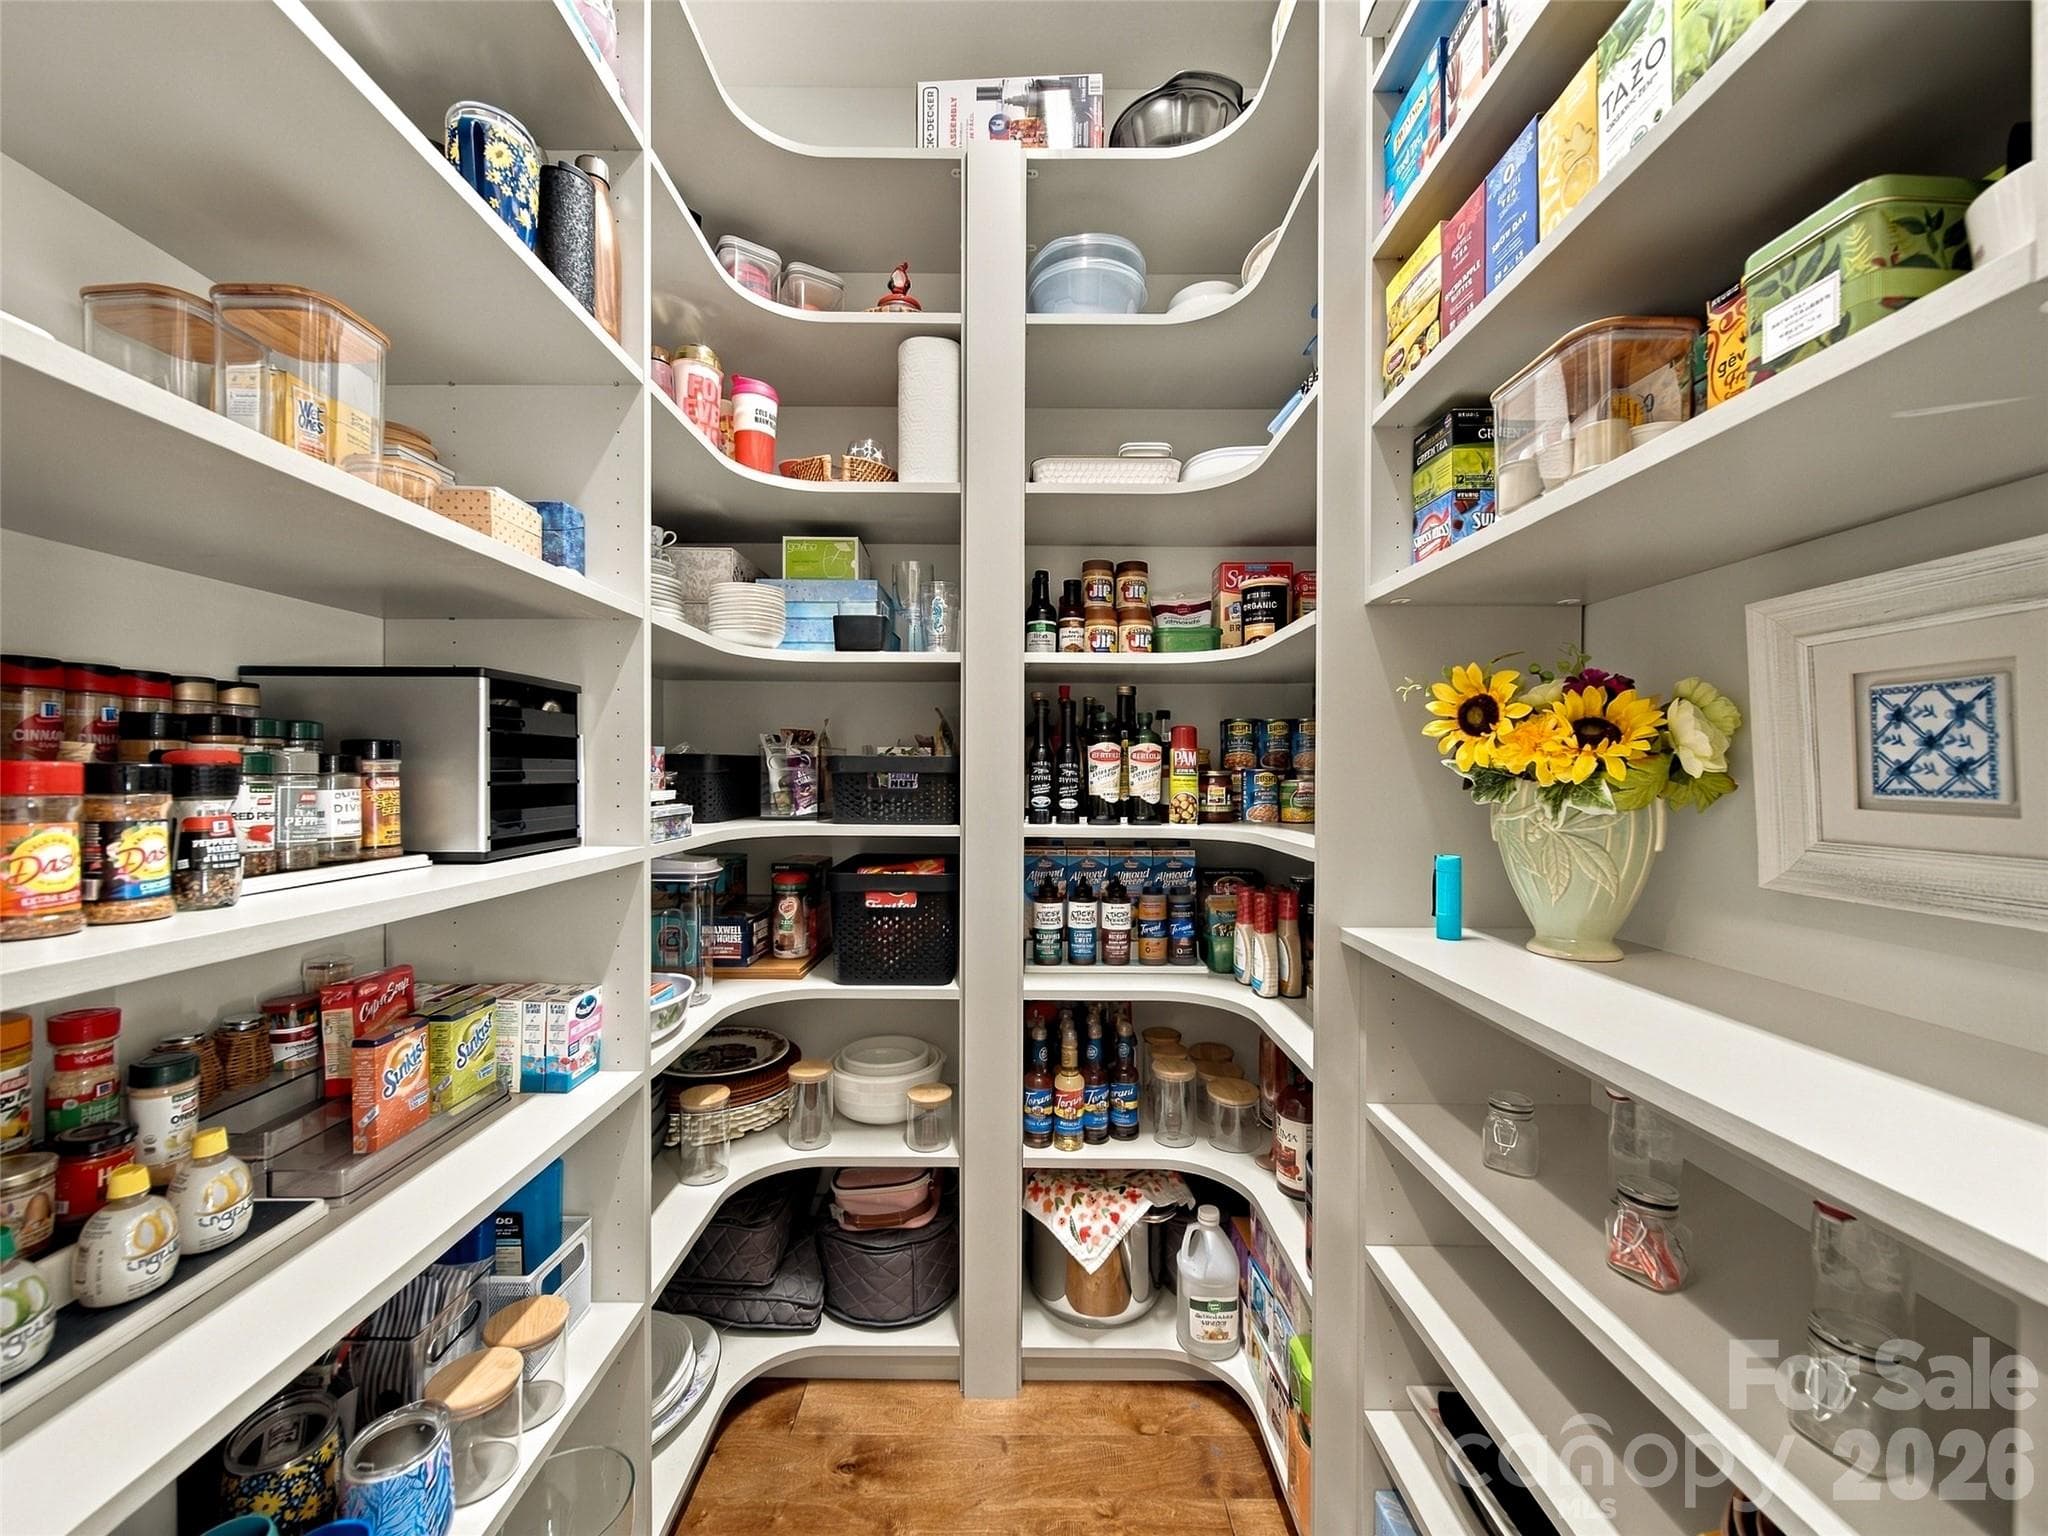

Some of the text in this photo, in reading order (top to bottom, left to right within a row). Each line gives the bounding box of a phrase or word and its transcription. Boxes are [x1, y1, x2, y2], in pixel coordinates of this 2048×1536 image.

[1602, 37, 1666, 120] TAZO
[926, 91, 935, 148] K+DECKER
[1512, 211, 1528, 234] DAY
[1243, 600, 1278, 611] ORGANIC
[1174, 751, 1197, 766] PAM
[231, 812, 255, 821] RED
[1155, 867, 1194, 883] Almond
[716, 934, 743, 944] HOUSE
[457, 1011, 493, 1069] Sunkist
[383, 1033, 428, 1099] Sunkist
